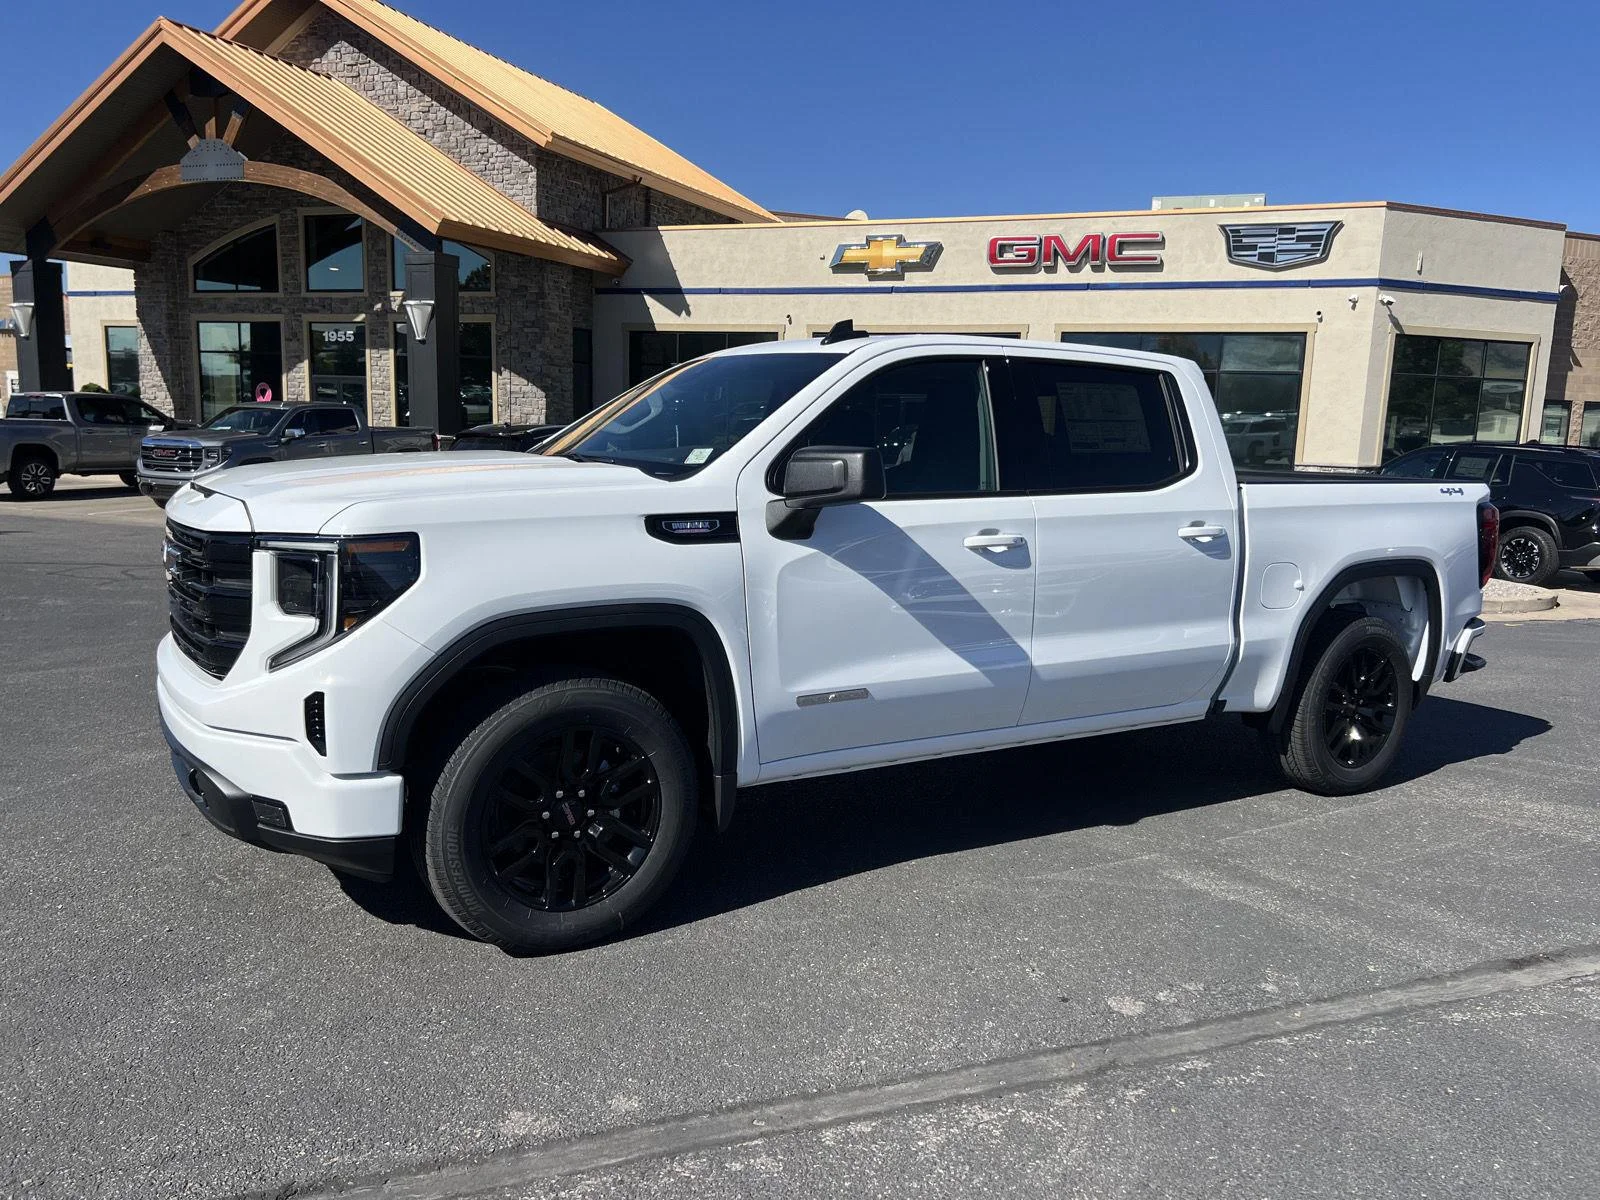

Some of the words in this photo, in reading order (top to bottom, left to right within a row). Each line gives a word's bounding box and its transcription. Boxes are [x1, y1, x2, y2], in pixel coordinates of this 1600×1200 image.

[987, 232, 1163, 268] GMC
[322, 330, 355, 342] 1955
[152, 449, 176, 457] GMC
